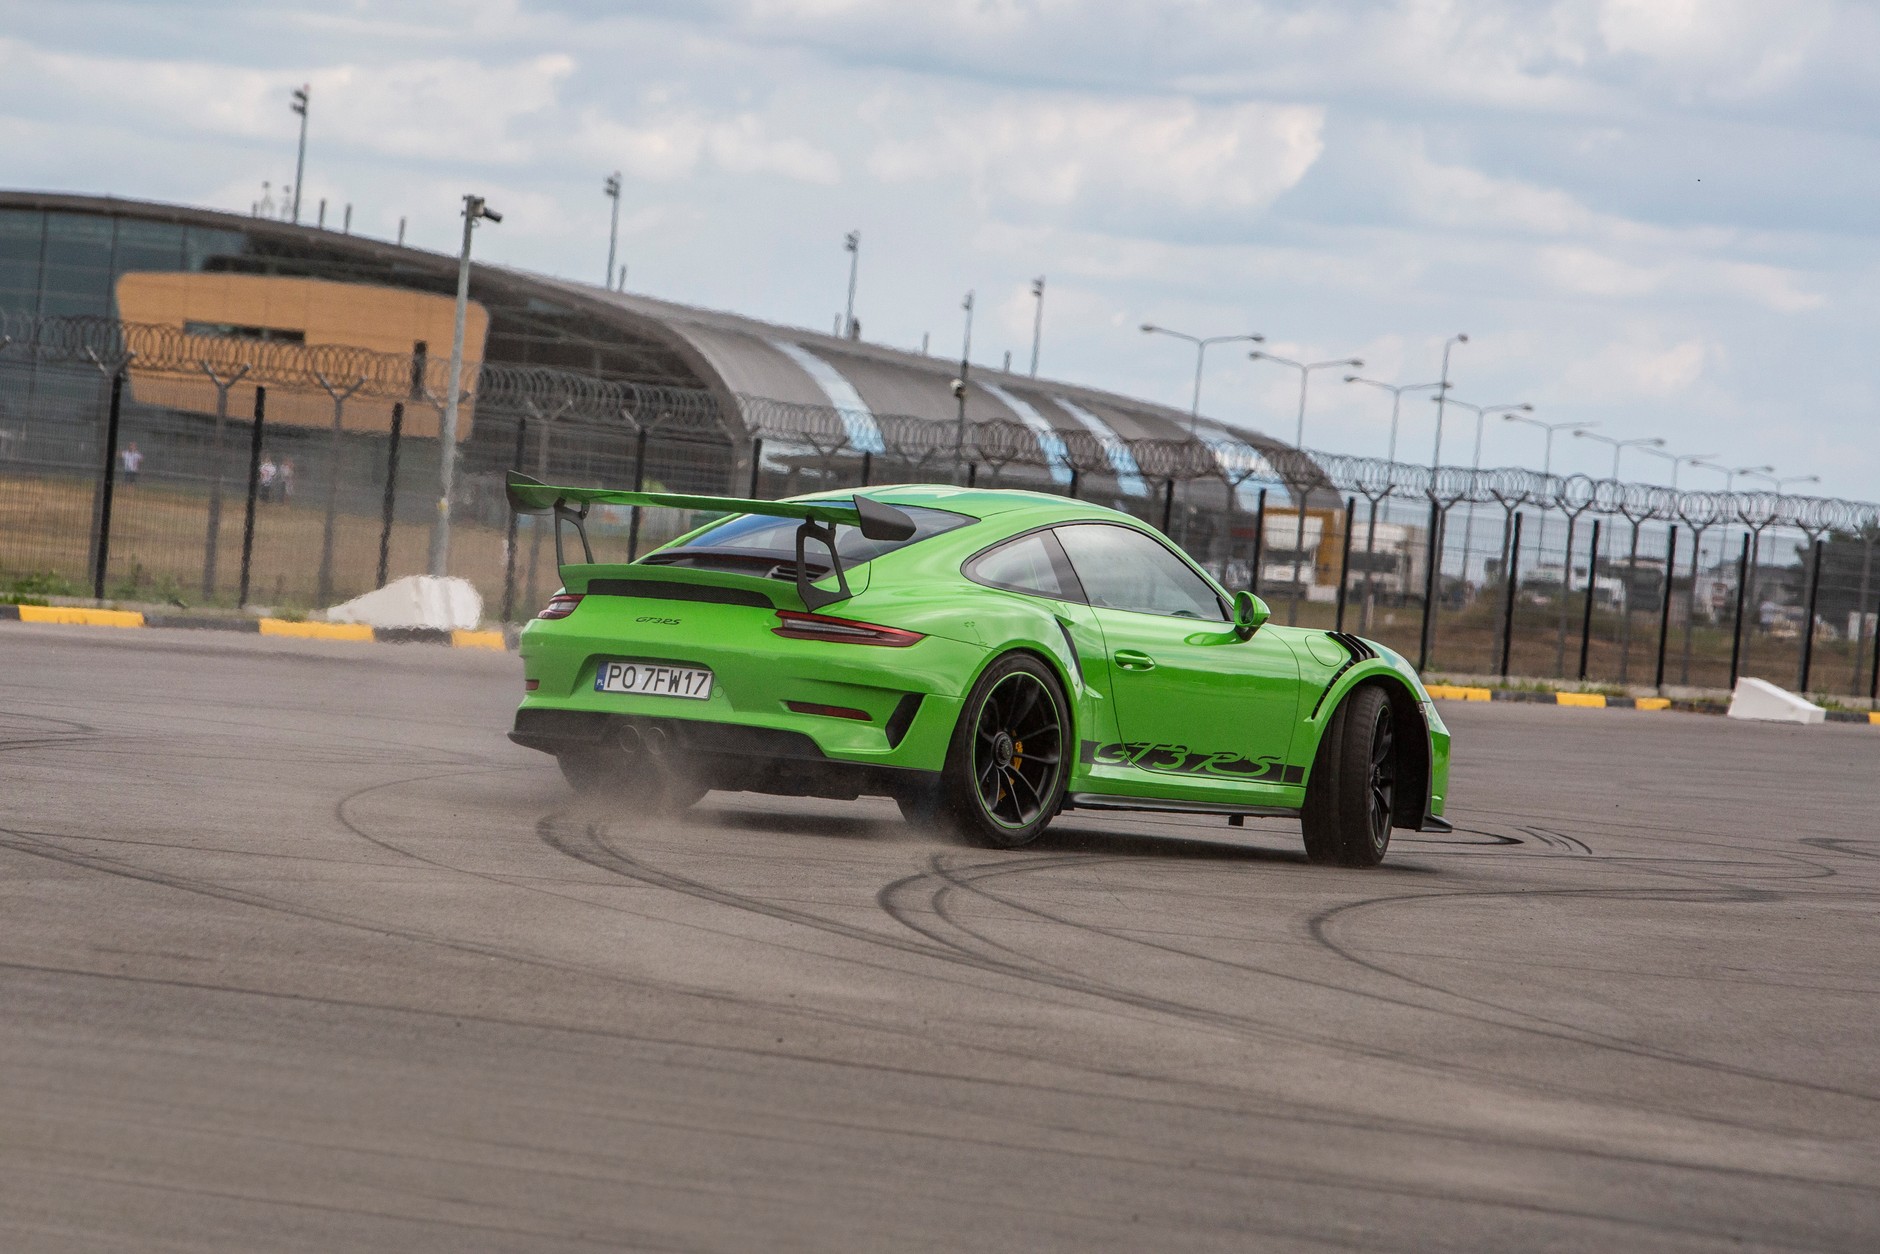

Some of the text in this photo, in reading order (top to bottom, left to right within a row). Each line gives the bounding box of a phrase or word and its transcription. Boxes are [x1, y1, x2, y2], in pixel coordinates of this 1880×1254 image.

[596, 678, 604, 686] PL
[606, 665, 709, 695] PO 7FW17
[1093, 742, 1282, 777] GT3 RS
